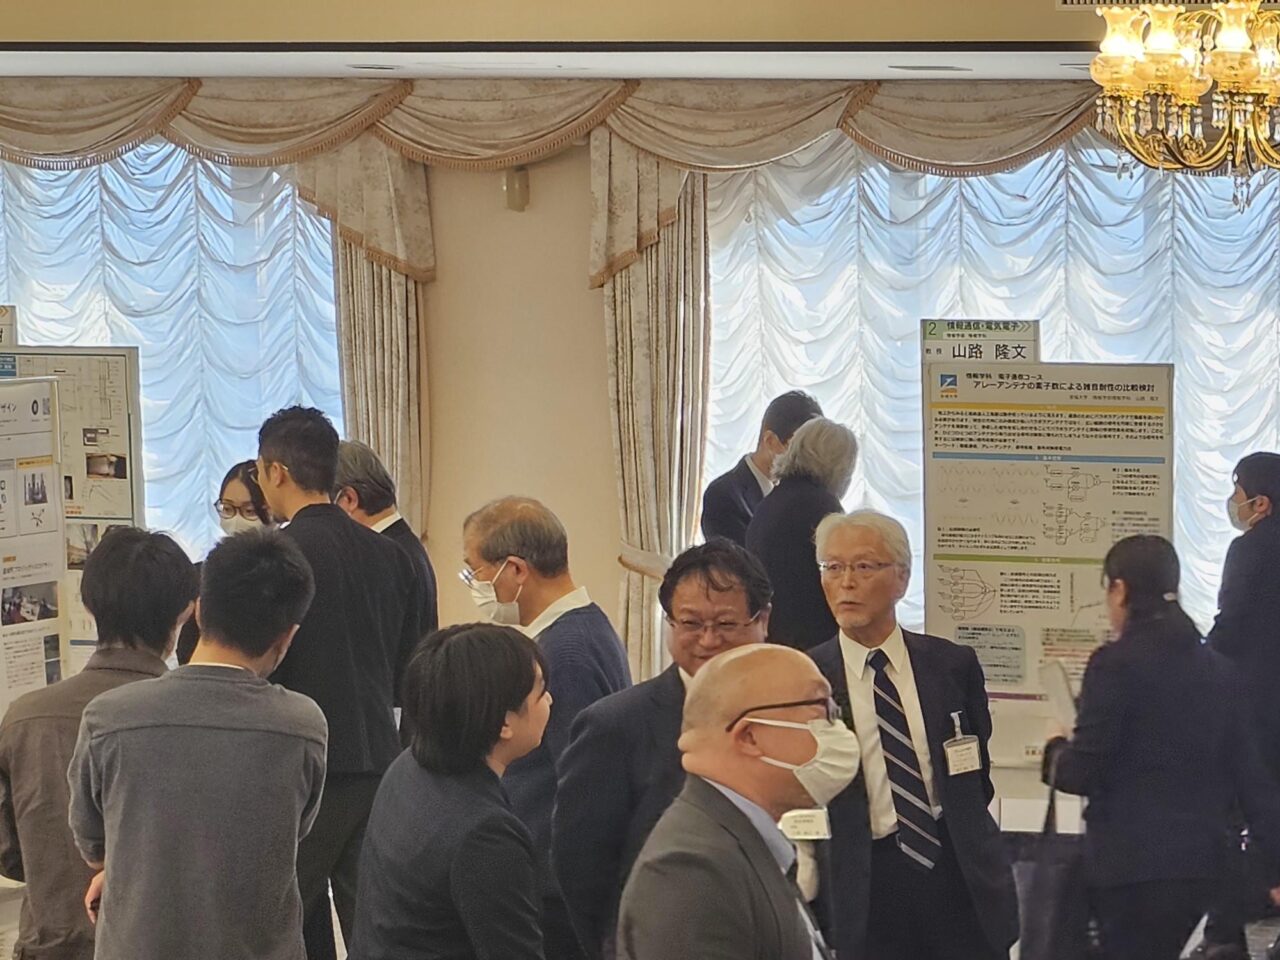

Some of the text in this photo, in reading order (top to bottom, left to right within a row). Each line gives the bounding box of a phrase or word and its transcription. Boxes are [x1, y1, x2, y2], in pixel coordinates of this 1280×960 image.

[928, 321, 937, 336] 2
[946, 320, 1019, 331] 情報通信・電気電子
[952, 343, 1027, 360] 山路 隆文
